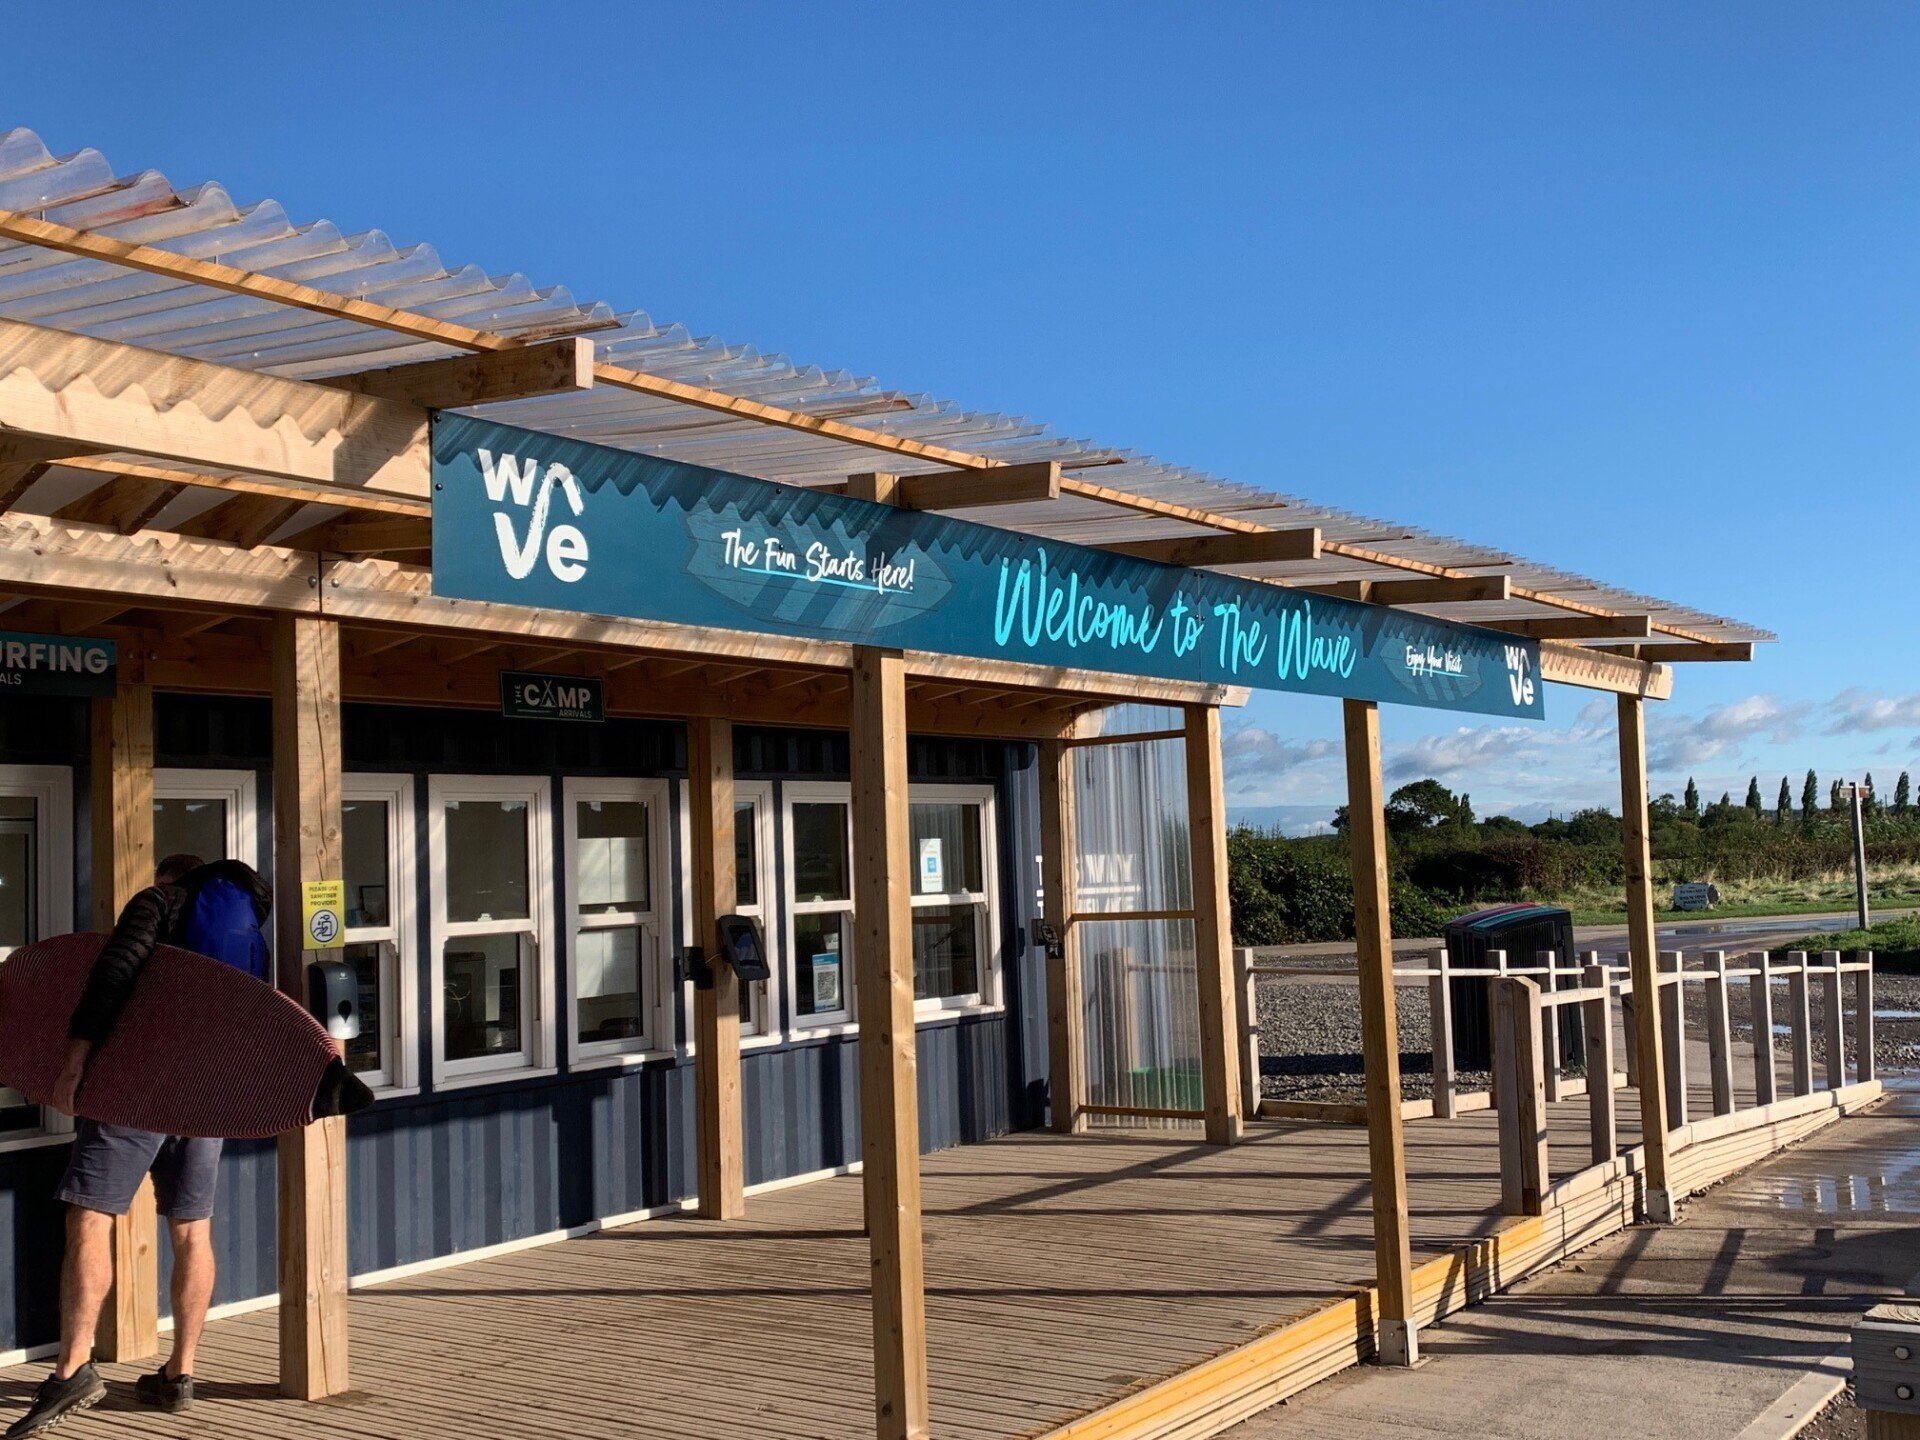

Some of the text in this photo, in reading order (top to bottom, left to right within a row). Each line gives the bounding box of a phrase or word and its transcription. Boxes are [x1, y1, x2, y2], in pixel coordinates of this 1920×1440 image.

[721, 528, 915, 595] The Fun Starts Here!
[994, 547, 1357, 680] Welcome to The Wave
[0, 641, 109, 674] RFING
[514, 684, 522, 704] THE
[524, 680, 592, 709] CAMP
[559, 709, 592, 719] ARRIVALS
